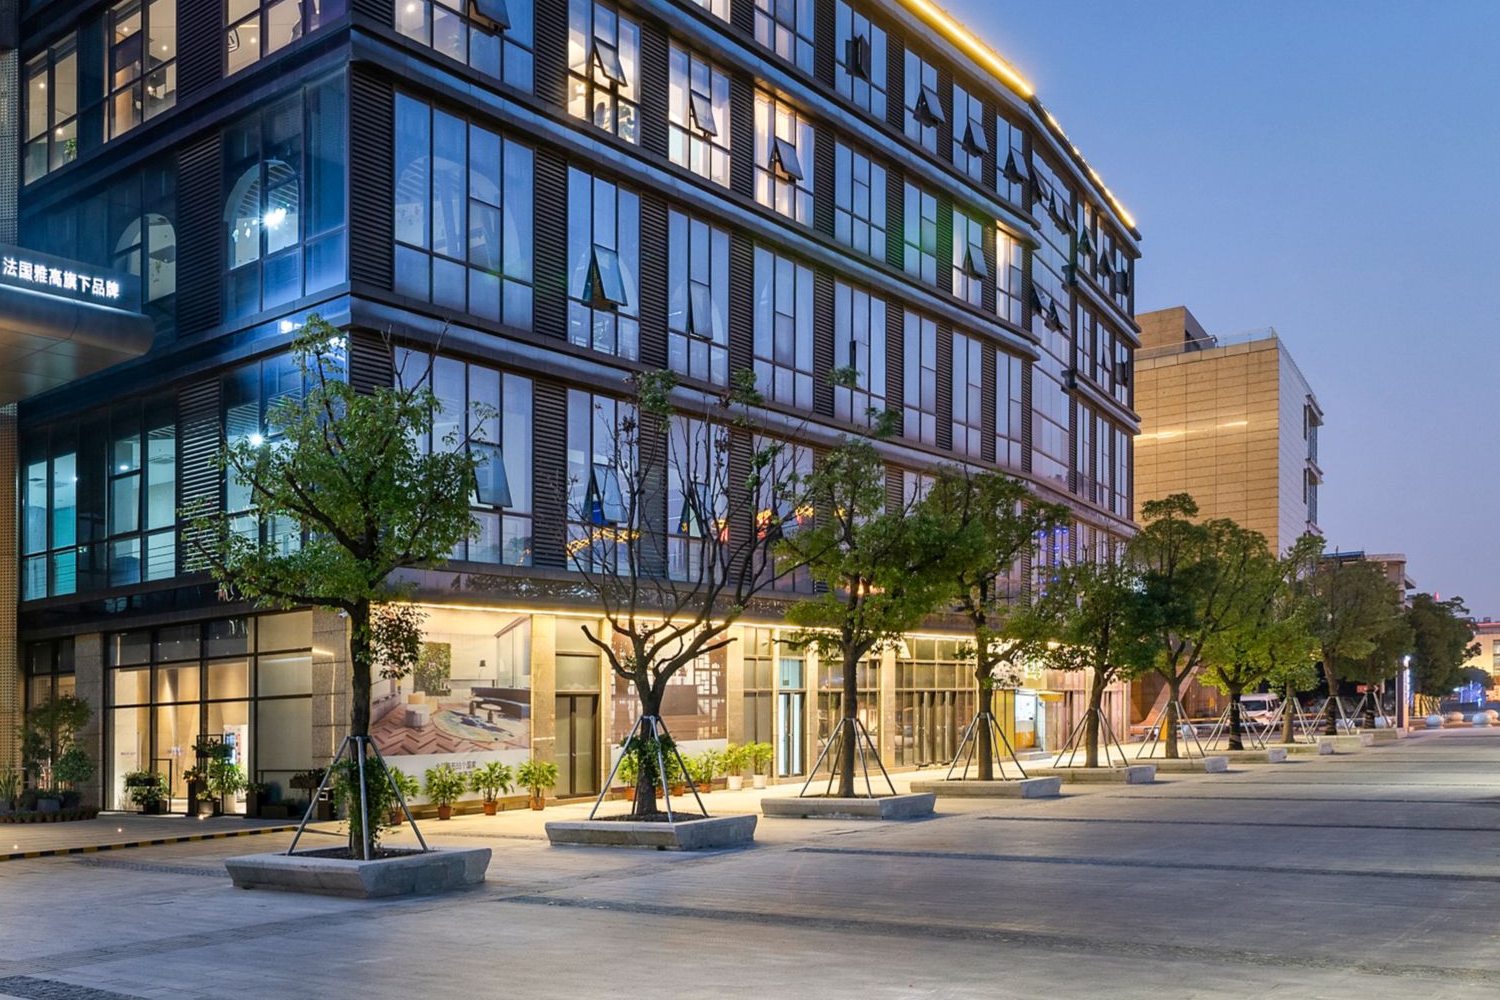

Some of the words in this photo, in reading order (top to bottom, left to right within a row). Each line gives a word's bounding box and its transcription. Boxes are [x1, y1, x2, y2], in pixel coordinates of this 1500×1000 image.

[2, 256, 120, 299] 法国雅高旗下品牌
